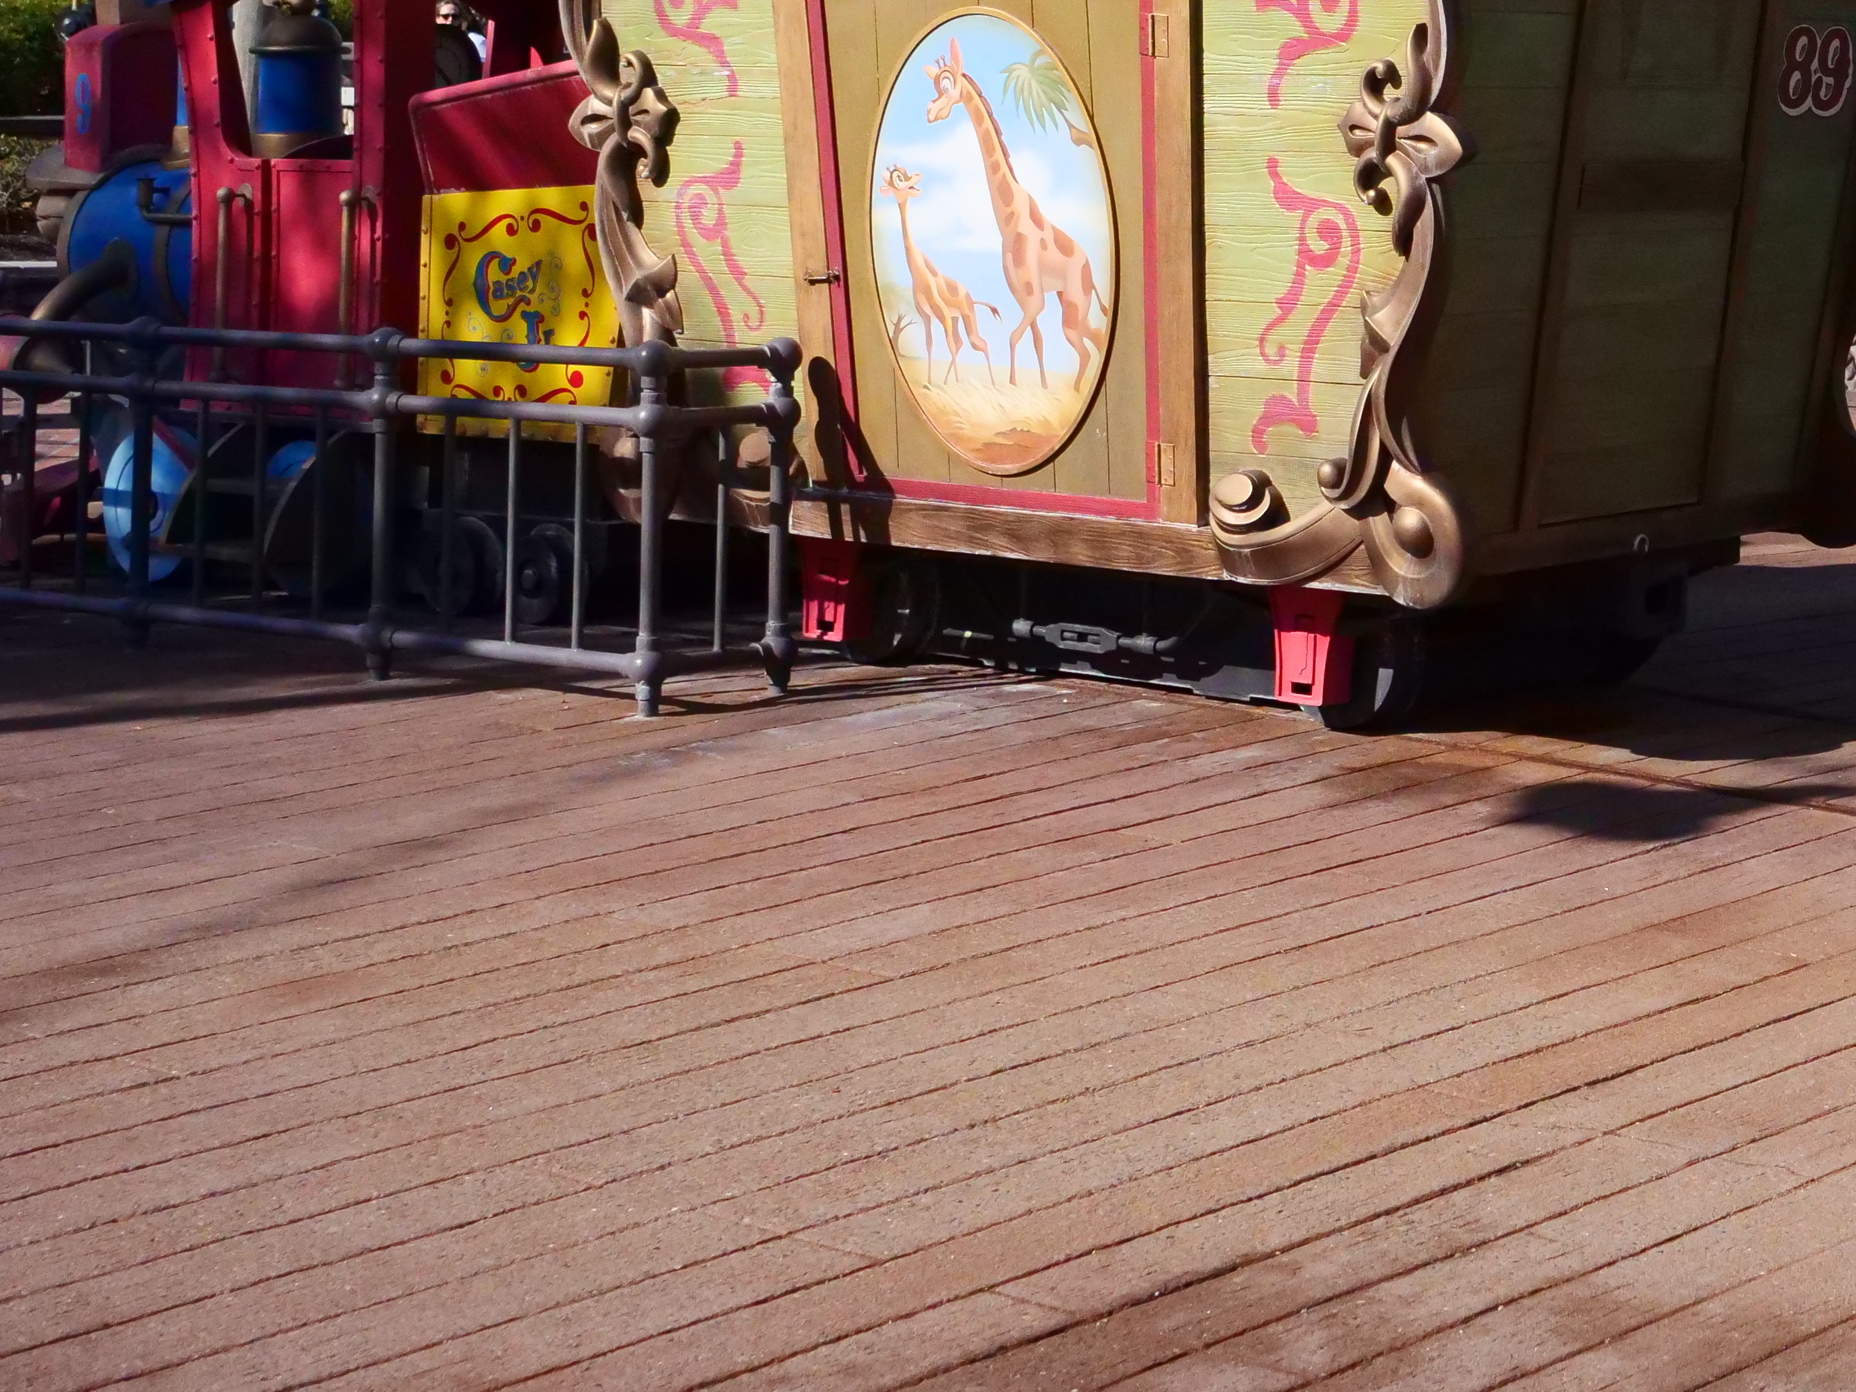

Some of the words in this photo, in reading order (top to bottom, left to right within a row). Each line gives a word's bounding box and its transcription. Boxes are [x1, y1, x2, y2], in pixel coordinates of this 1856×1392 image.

[75, 73, 91, 135] 9
[1777, 24, 1853, 116] 89
[473, 251, 542, 323] Casey
